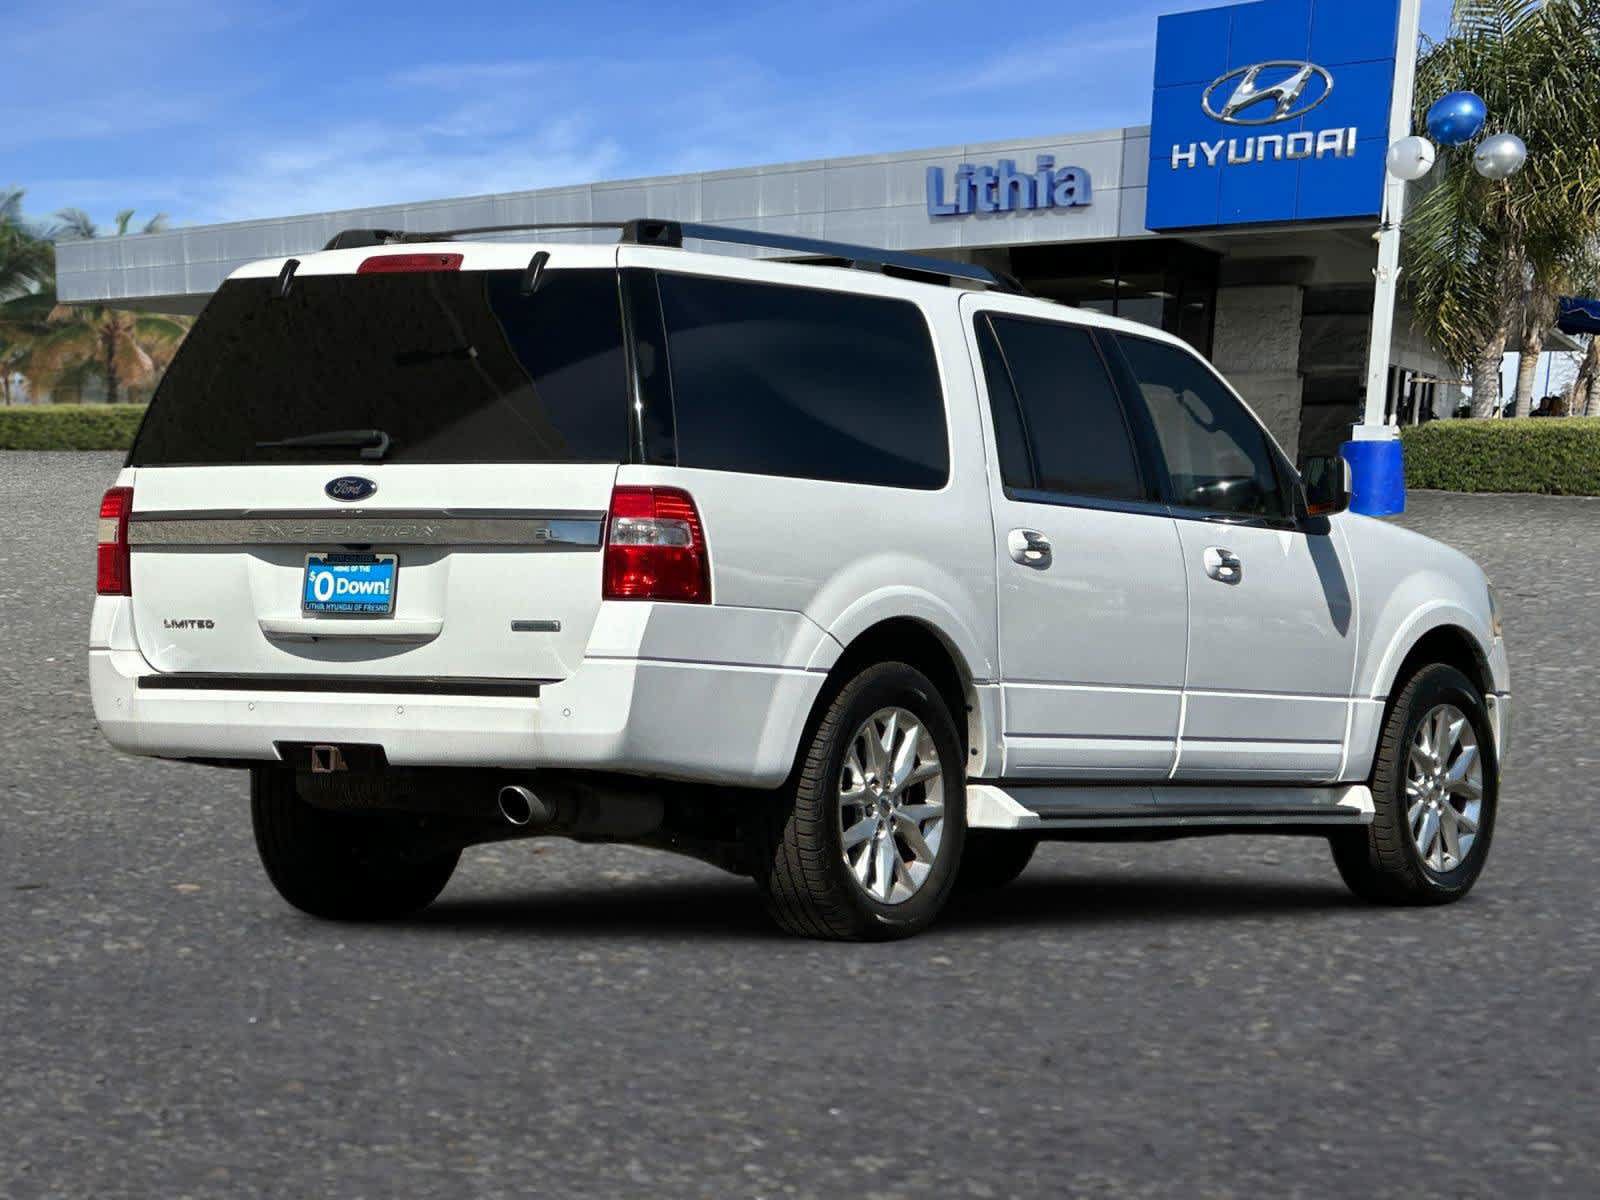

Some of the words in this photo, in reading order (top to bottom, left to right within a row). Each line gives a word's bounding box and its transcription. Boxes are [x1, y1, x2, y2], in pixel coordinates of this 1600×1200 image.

[1171, 127, 1357, 169] HYUNDAI
[926, 155, 1091, 217] Lithia
[333, 479, 363, 495] Ford
[249, 524, 441, 538] EXPEDITION
[336, 577, 391, 596] Down!
[163, 618, 215, 629] LIMITED
